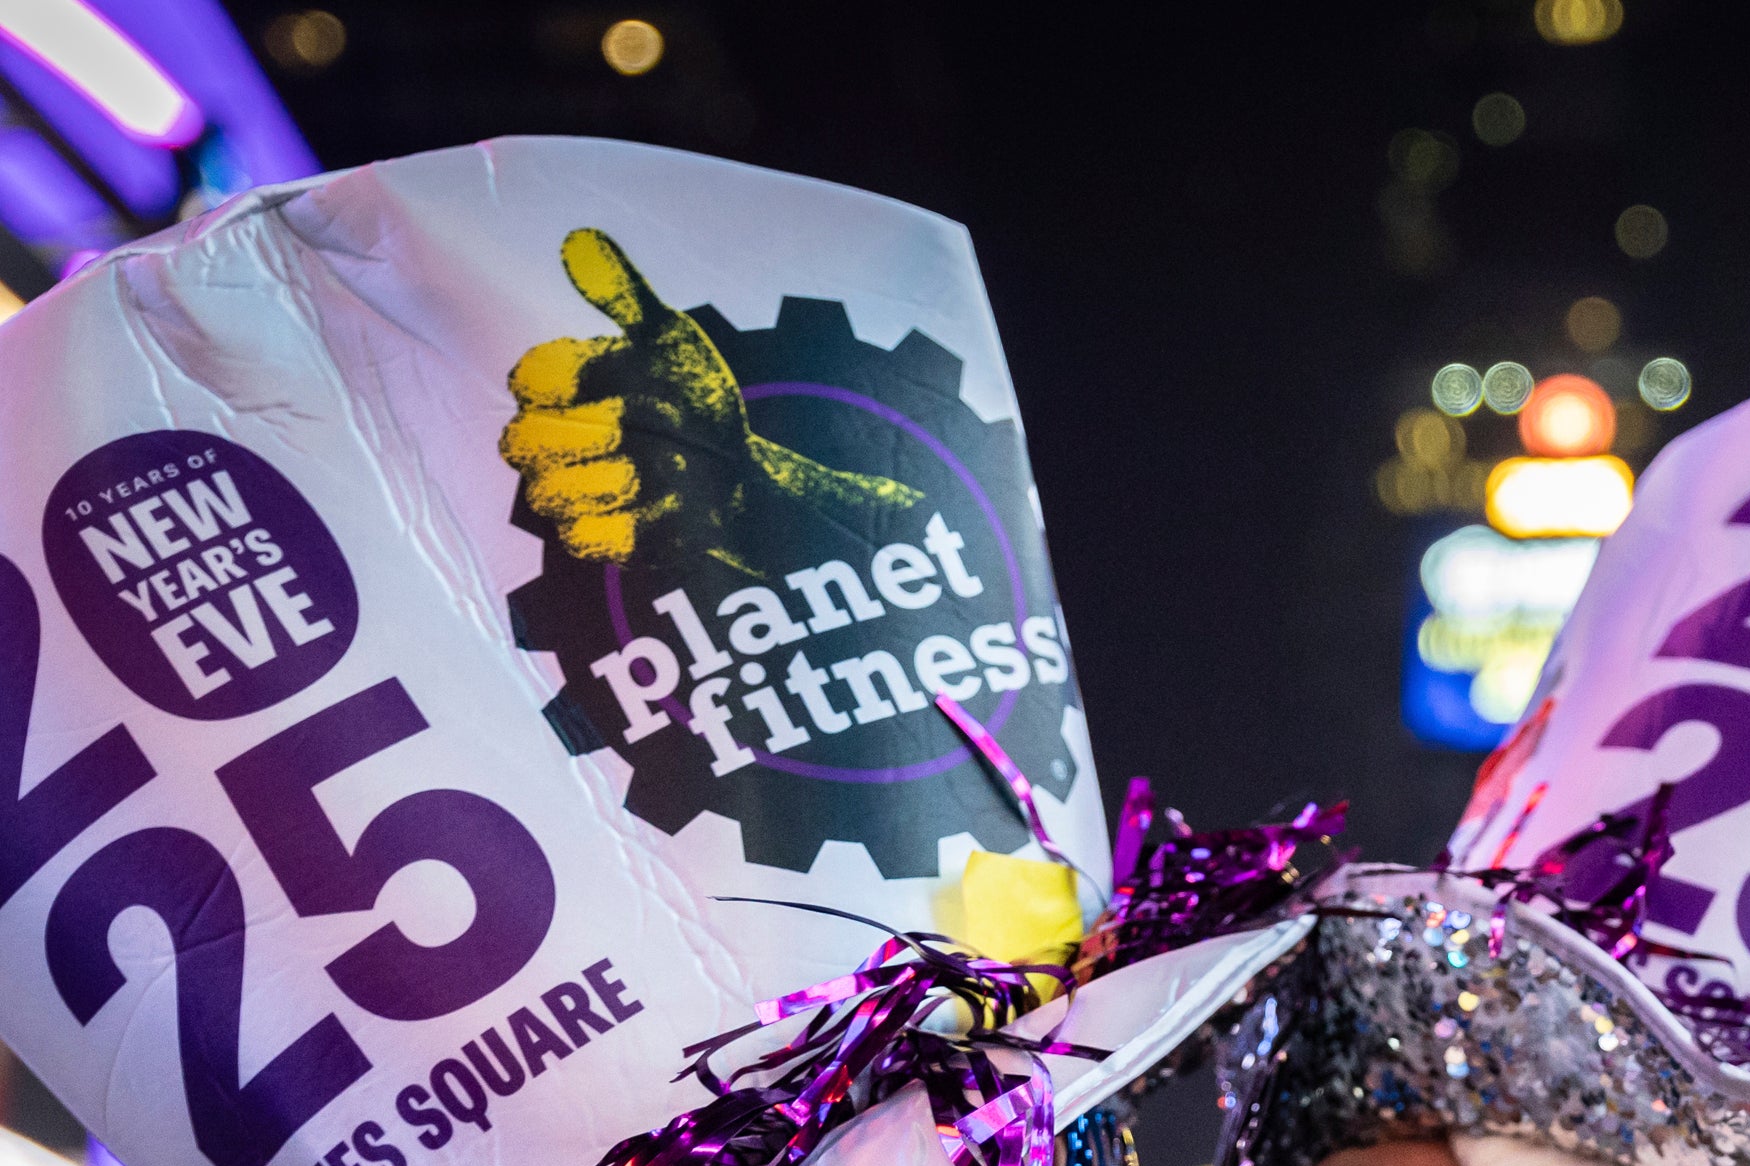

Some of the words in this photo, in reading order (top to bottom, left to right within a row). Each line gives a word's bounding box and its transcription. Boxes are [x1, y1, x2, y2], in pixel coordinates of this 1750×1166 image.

[64, 499, 93, 521] 10
[99, 462, 181, 504] YEARS
[186, 448, 218, 470] OF
[78, 468, 252, 584] NEW
[117, 528, 284, 622] YEAR'S
[150, 565, 336, 700] EVE
[591, 512, 984, 744] planet
[688, 615, 1069, 777] fitness
[396, 958, 645, 1150] SQUARE
